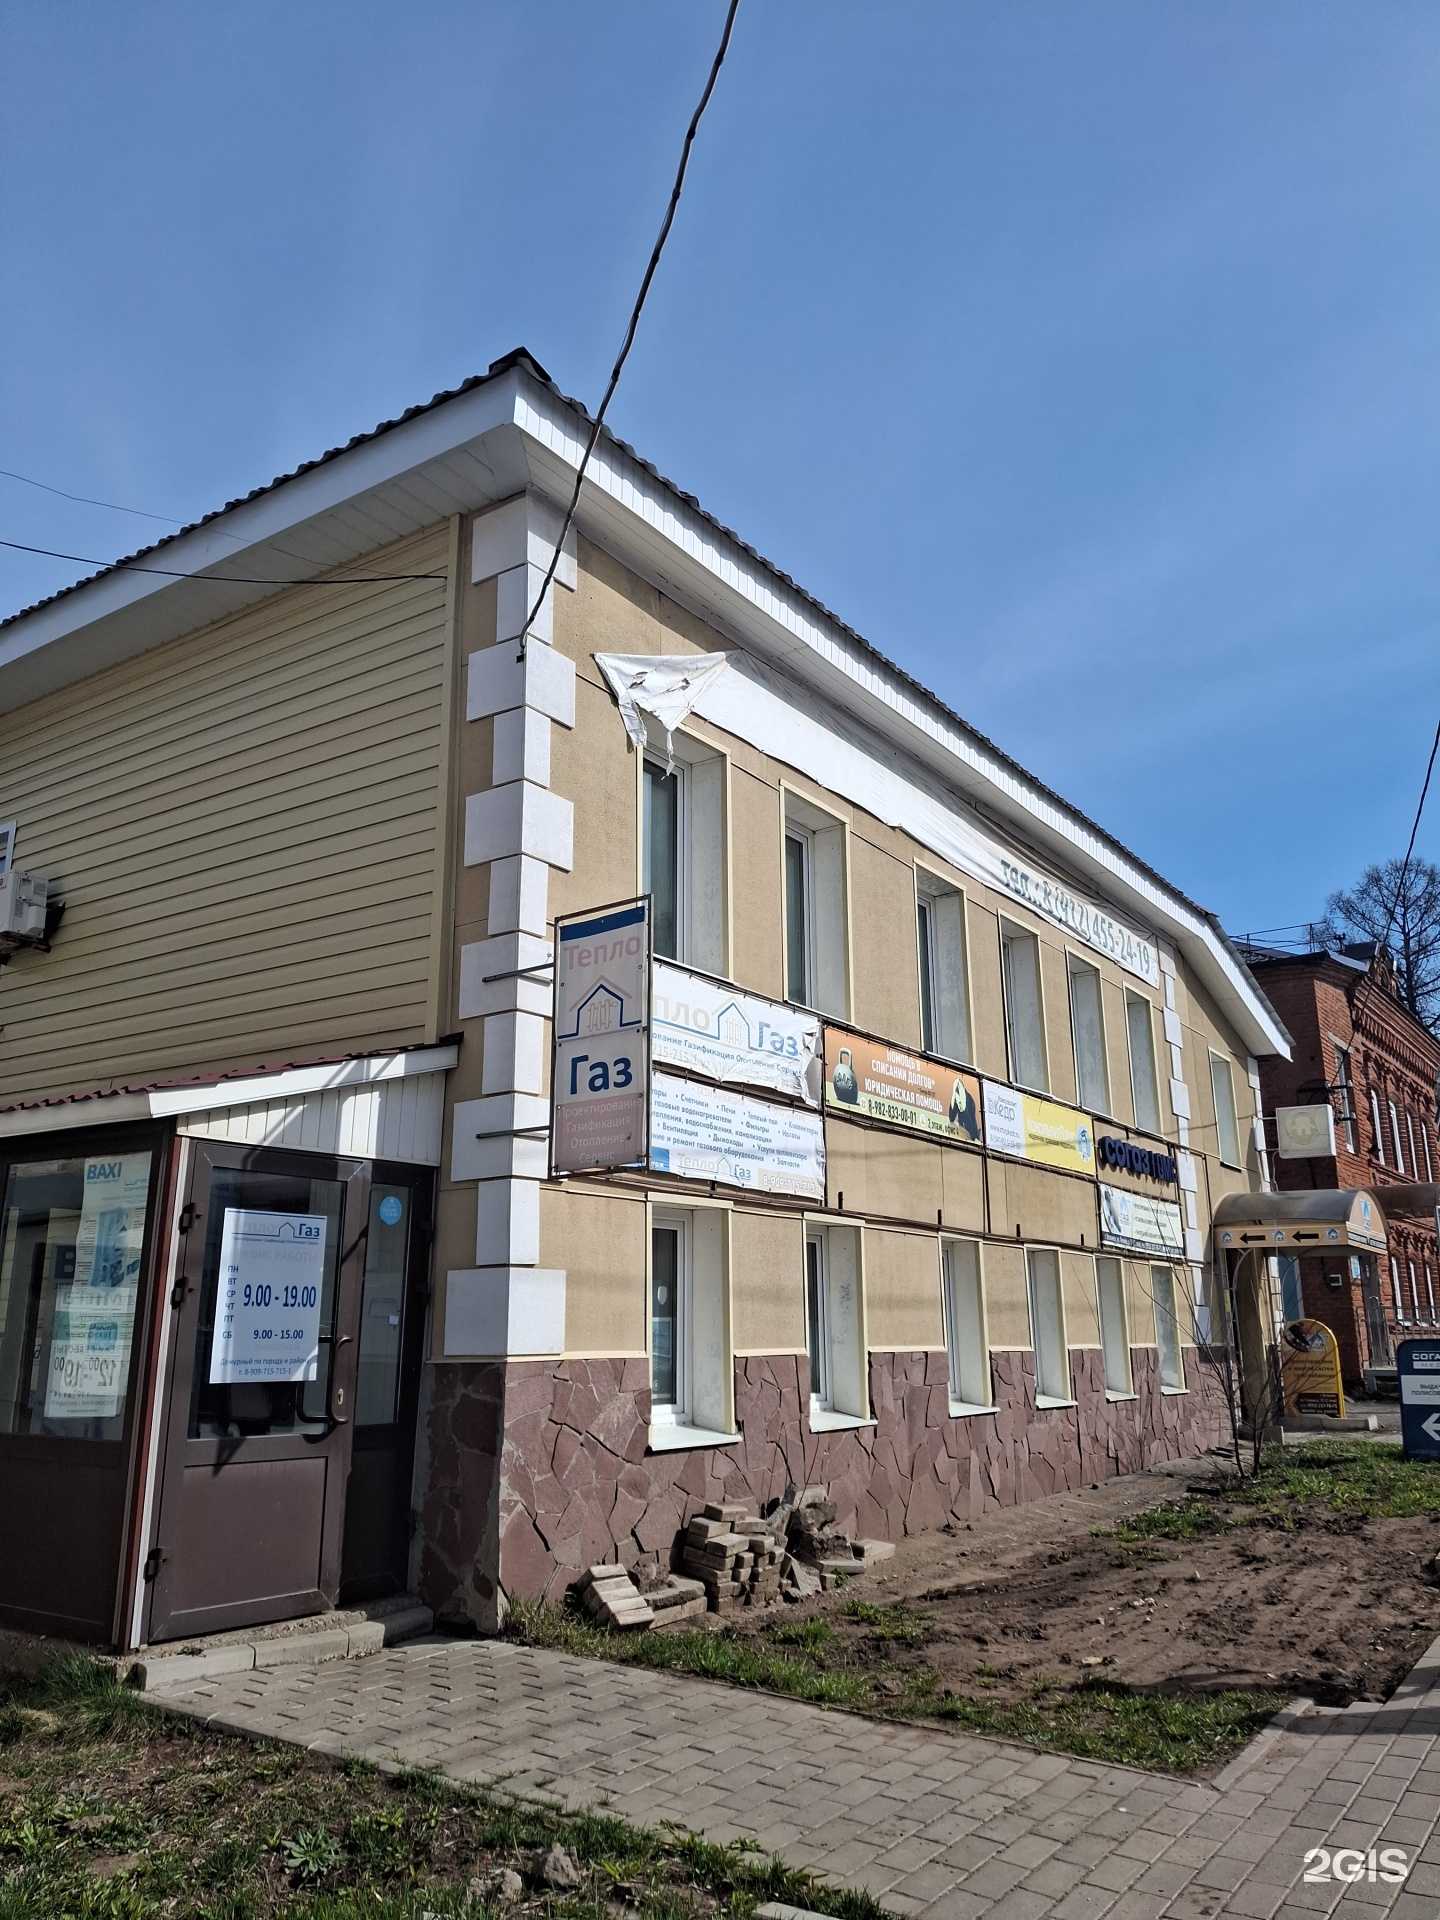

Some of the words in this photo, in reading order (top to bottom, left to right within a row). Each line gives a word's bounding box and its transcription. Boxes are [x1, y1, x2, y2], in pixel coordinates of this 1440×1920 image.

[563, 936, 641, 970] Тепло
[653, 995, 710, 1030] пло
[758, 1021, 798, 1056] Газ
[684, 1040, 734, 1062] Газификация
[569, 1054, 633, 1095] Газ
[872, 1060, 907, 1081] СПИСАНИИ
[864, 1078, 916, 1105] ЮРИДИЧЕСКАЯ
[916, 1095, 943, 1112] ПОМОЩЬ
[662, 1122, 698, 1137] Вентиляция
[673, 1137, 695, 1148] ремонт
[86, 1161, 122, 1180] BAXI
[734, 1164, 751, 1178] Газ
[298, 1223, 320, 1237] Газ
[228, 1265, 239, 1273] ПН
[228, 1278, 238, 1286] ВТ
[243, 1284, 272, 1307] 9.00
[283, 1286, 316, 1308] 19.00
[223, 1315, 235, 1323] ПТ
[222, 1331, 232, 1339] СБ
[253, 1329, 272, 1339] 9.00
[280, 1329, 304, 1339] 15.00
